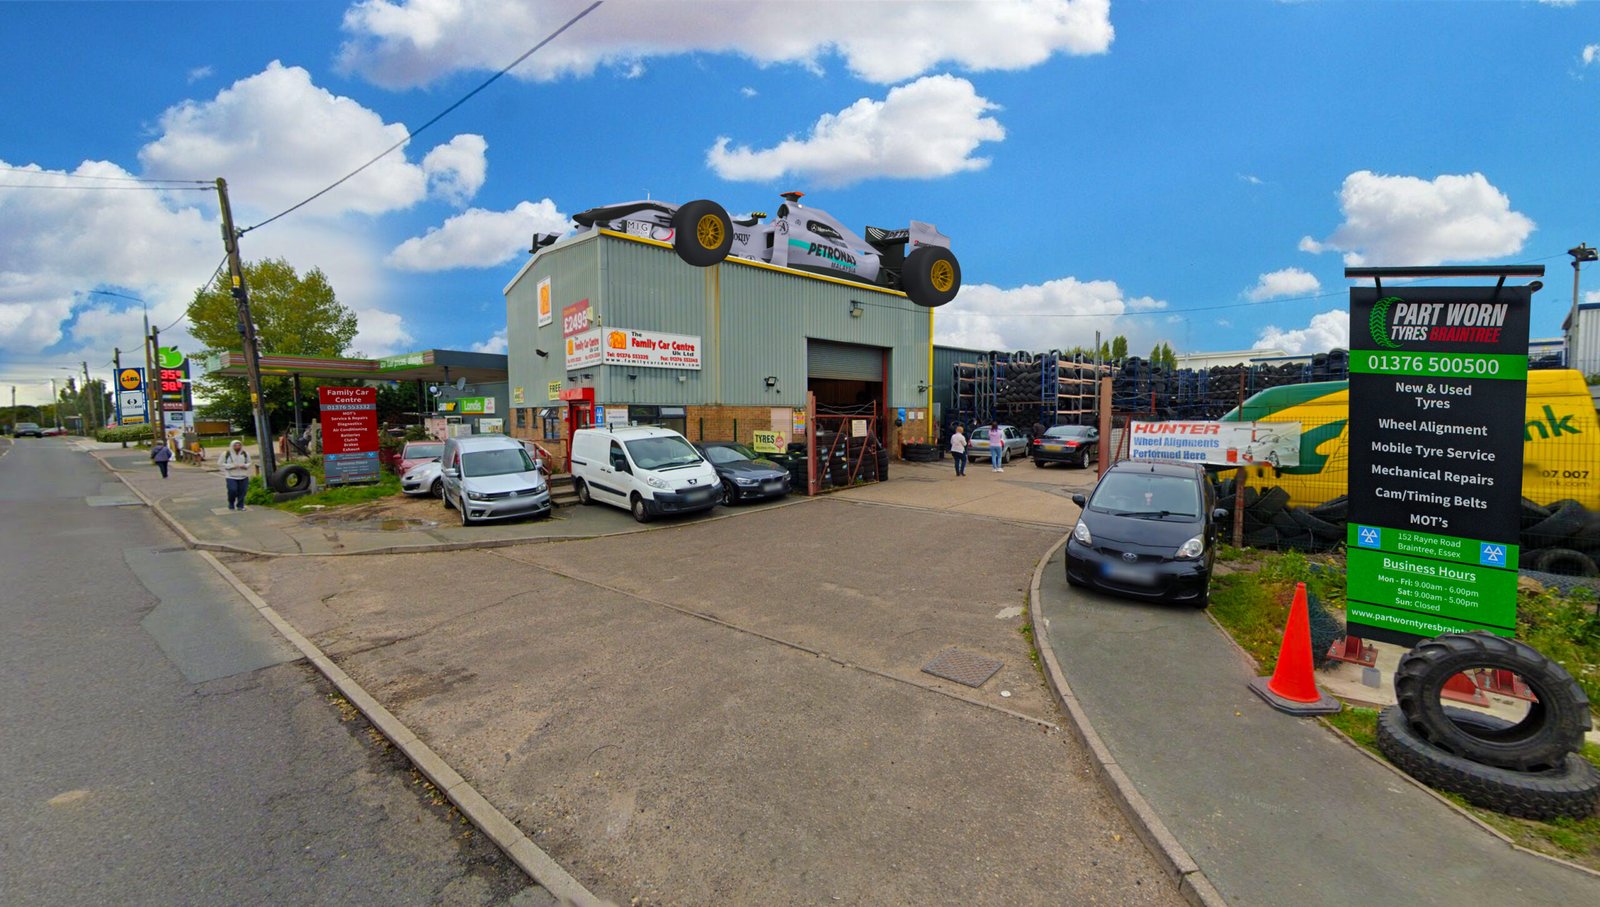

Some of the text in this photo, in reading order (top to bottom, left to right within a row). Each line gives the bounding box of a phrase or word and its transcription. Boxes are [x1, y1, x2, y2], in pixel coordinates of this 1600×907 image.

[627, 220, 648, 232] MIG
[807, 242, 857, 266] PETRONAS
[565, 310, 588, 334] £2495
[1393, 303, 1509, 327] PART WORN
[1391, 326, 1503, 343] TYRES BRAINTREE
[631, 338, 695, 352] Family Car Centre
[1368, 355, 1500, 375] 01376 500500
[327, 389, 354, 397] Family
[549, 383, 561, 393] FREE
[1395, 382, 1472, 396] New & Used
[464, 400, 482, 411] Londis
[1415, 397, 1451, 410] Tyres
[1134, 424, 1221, 435] HUNTER
[1378, 418, 1488, 436] Wheel Alignment
[755, 434, 775, 443] TYRES
[1134, 437, 1219, 448] Wheel Alignments
[1133, 450, 1207, 460] Performed Here
[1371, 441, 1496, 462] Mobile Tyre Service
[1371, 464, 1494, 486] Mechanical Repairs
[1562, 470, 1589, 479] 007
[1375, 487, 1487, 509] Cam/Timing Belts
[1397, 533, 1462, 548] 152 Rayne Road
[1397, 543, 1461, 559] Braintree, Essex
[1383, 558, 1477, 582] Business Hours
[1378, 574, 1395, 583] Mon
[1400, 578, 1413, 587] Fri:
[1414, 581, 1443, 591] 9.00am
[1449, 586, 1479, 598] 6.00pm
[1395, 597, 1441, 612] Sun: Closed
[1397, 587, 1413, 597] Sat:
[1414, 590, 1443, 601] 9.00am
[1449, 597, 1479, 608] 5.00pm
